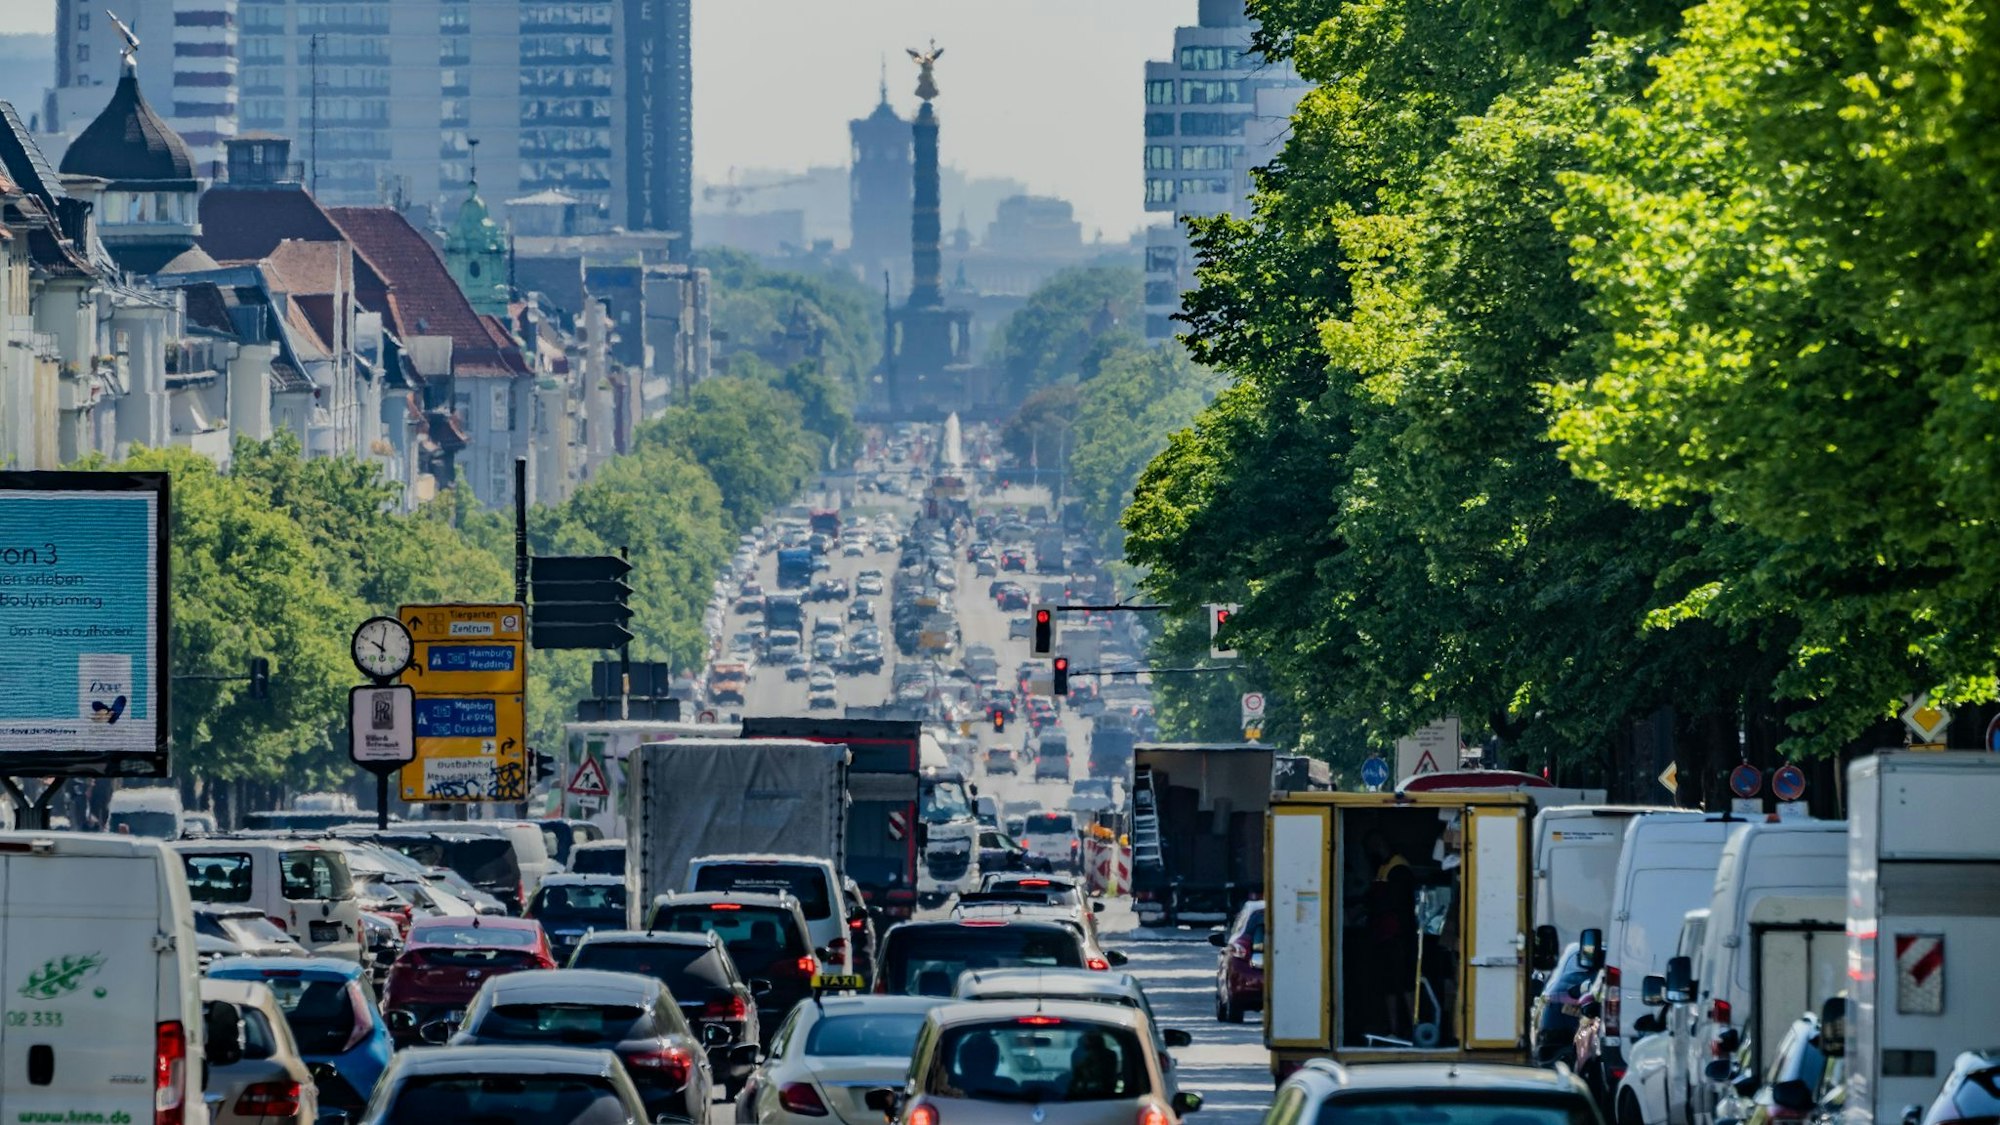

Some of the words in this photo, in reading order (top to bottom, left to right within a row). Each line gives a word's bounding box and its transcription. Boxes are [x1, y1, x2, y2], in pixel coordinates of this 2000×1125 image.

[0, 547, 37, 565] on
[43, 543, 58, 565] 3
[26, 573, 84, 586] erleben
[450, 610, 497, 620] Tiergarten
[10, 626, 33, 636] Das
[38, 627, 67, 637] muss
[452, 624, 491, 634] Zentrum
[469, 648, 512, 660] Hamburg
[470, 660, 510, 670] Wedding
[90, 681, 122, 693] Dove
[455, 701, 493, 711] Magdeburg
[461, 713, 494, 723] Leipzig
[454, 724, 494, 734] Dresden
[822, 975, 855, 985] TAXI
[32, 1011, 63, 1027] 333
